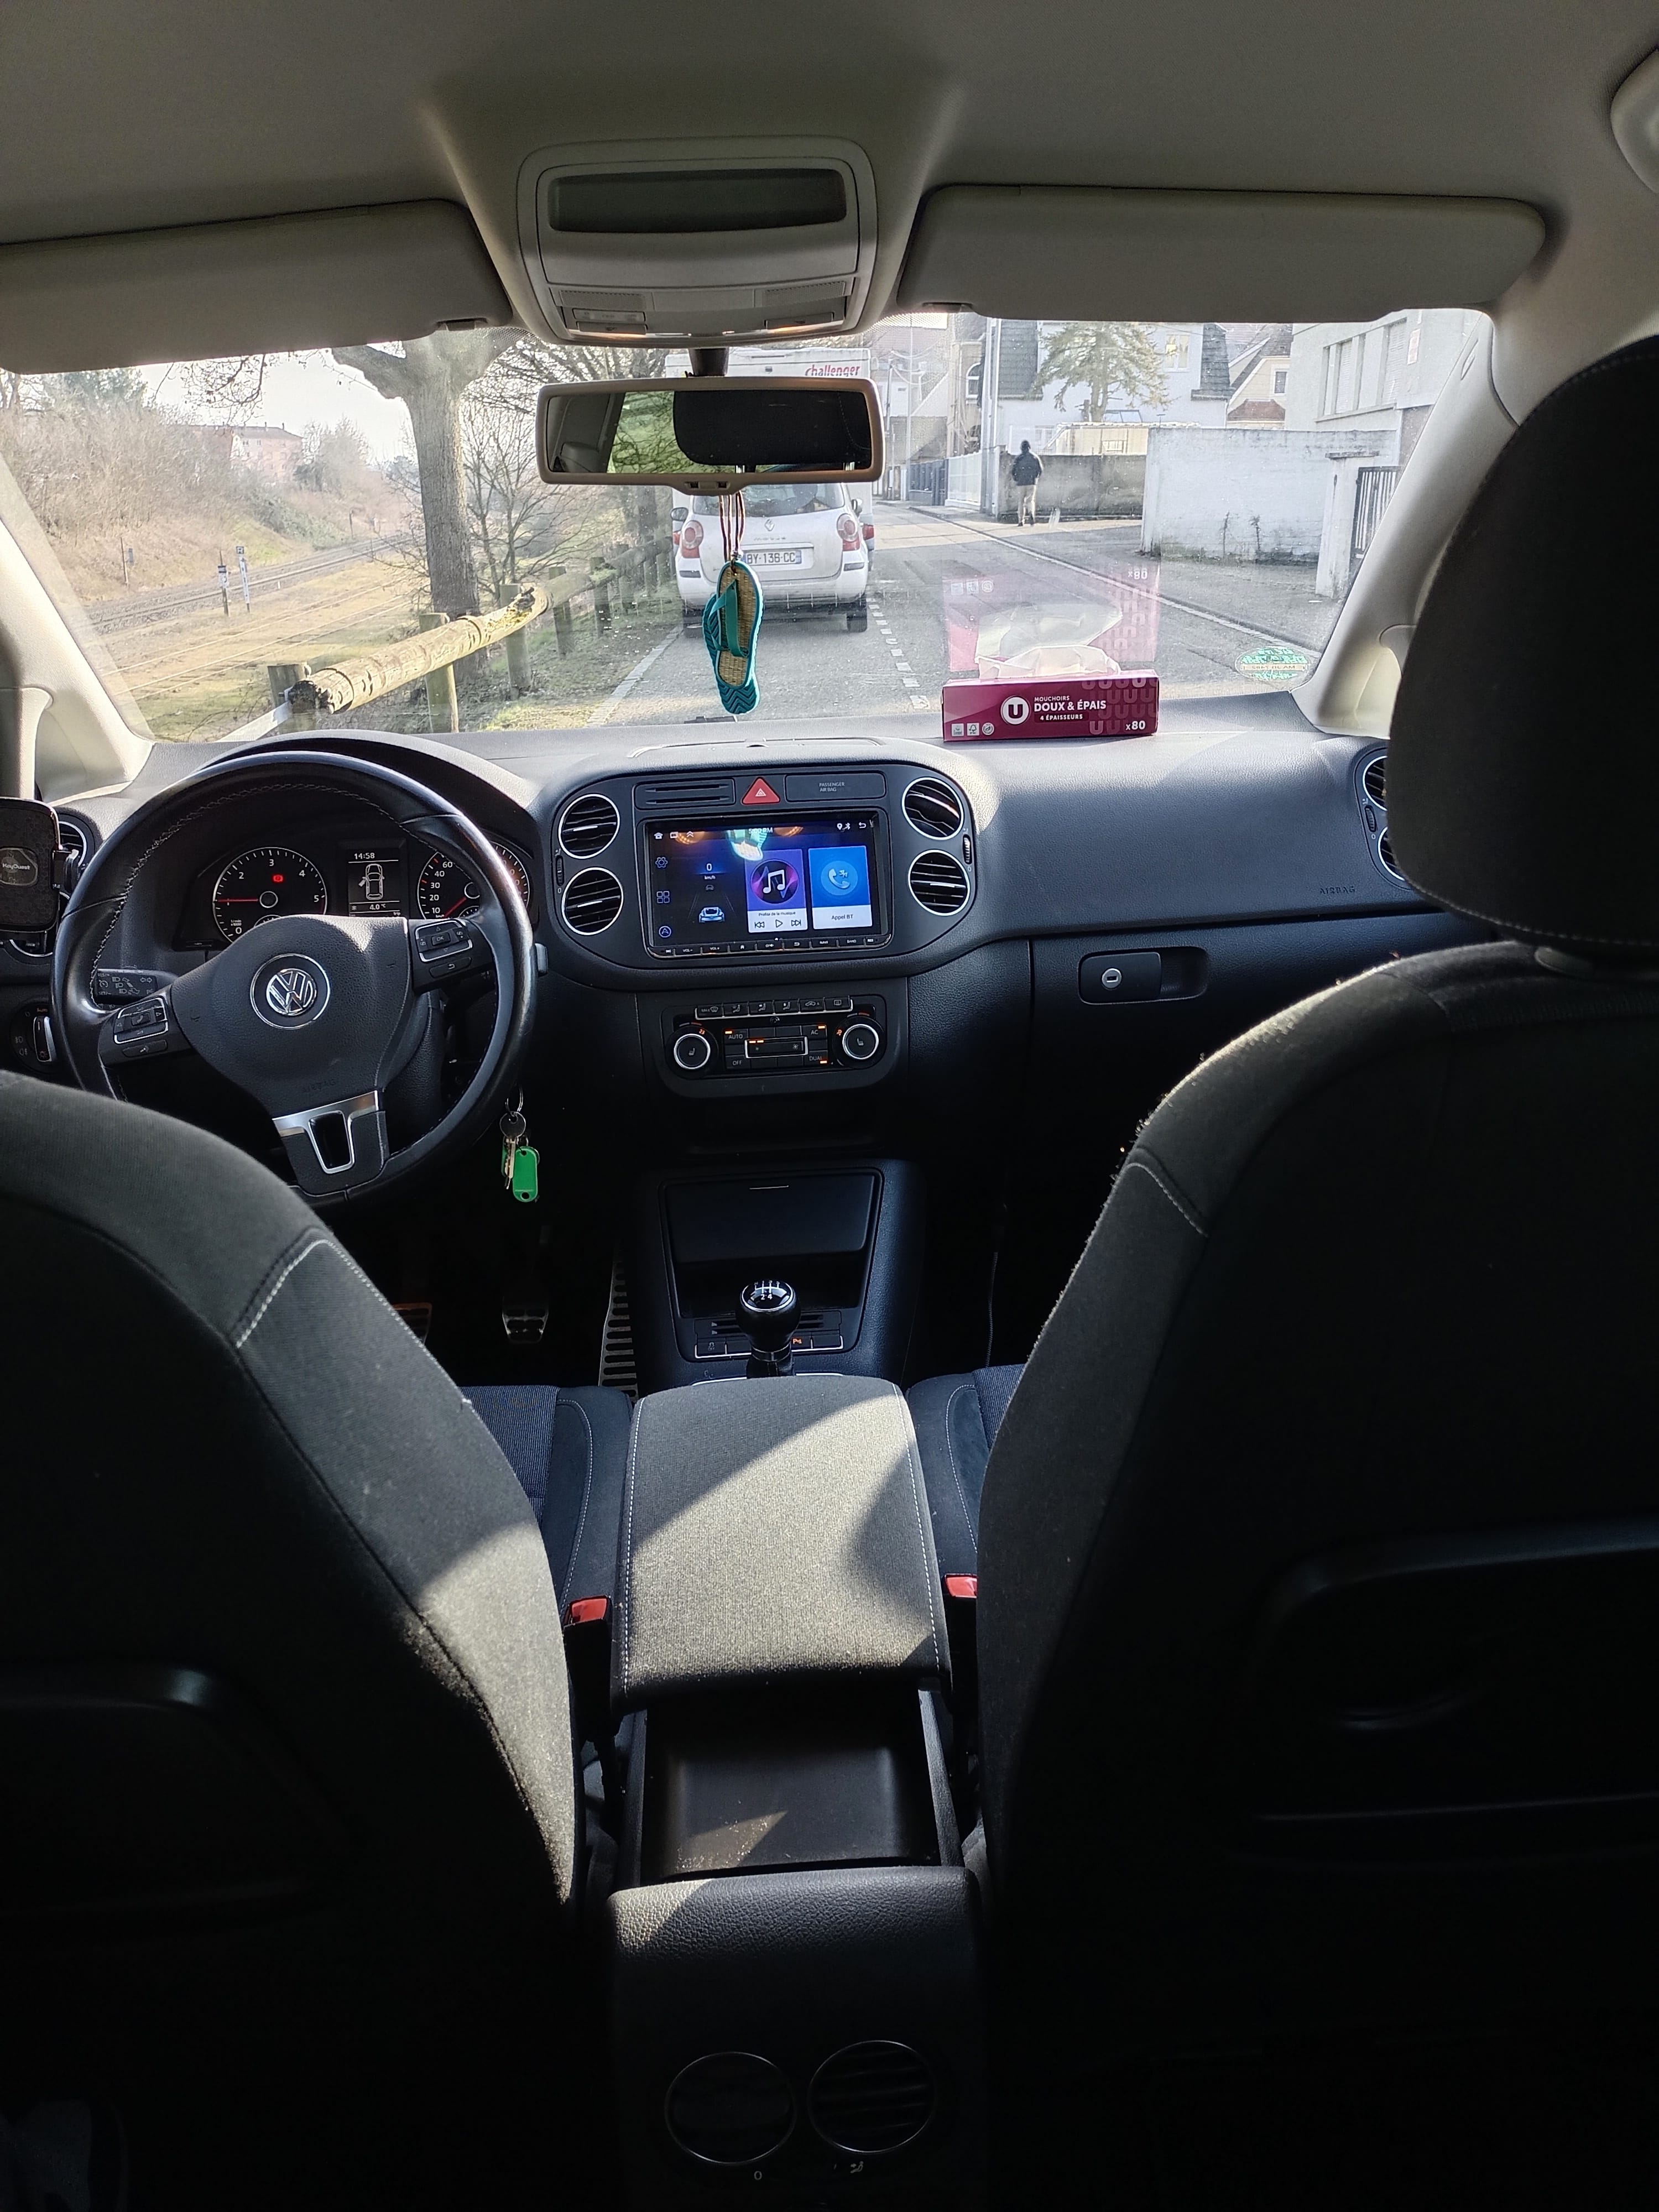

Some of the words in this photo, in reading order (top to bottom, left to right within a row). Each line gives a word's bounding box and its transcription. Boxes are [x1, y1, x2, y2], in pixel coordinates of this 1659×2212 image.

[805, 364, 860, 377] challenger
[747, 552, 795, 564] BY-136-CC
[1008, 703, 1023, 719] U
[1034, 702, 1065, 712] DOUX
[1067, 702, 1074, 711] &
[1077, 699, 1107, 710] ÉPAIS
[1125, 721, 1146, 731] x80
[706, 863, 712, 872] 0
